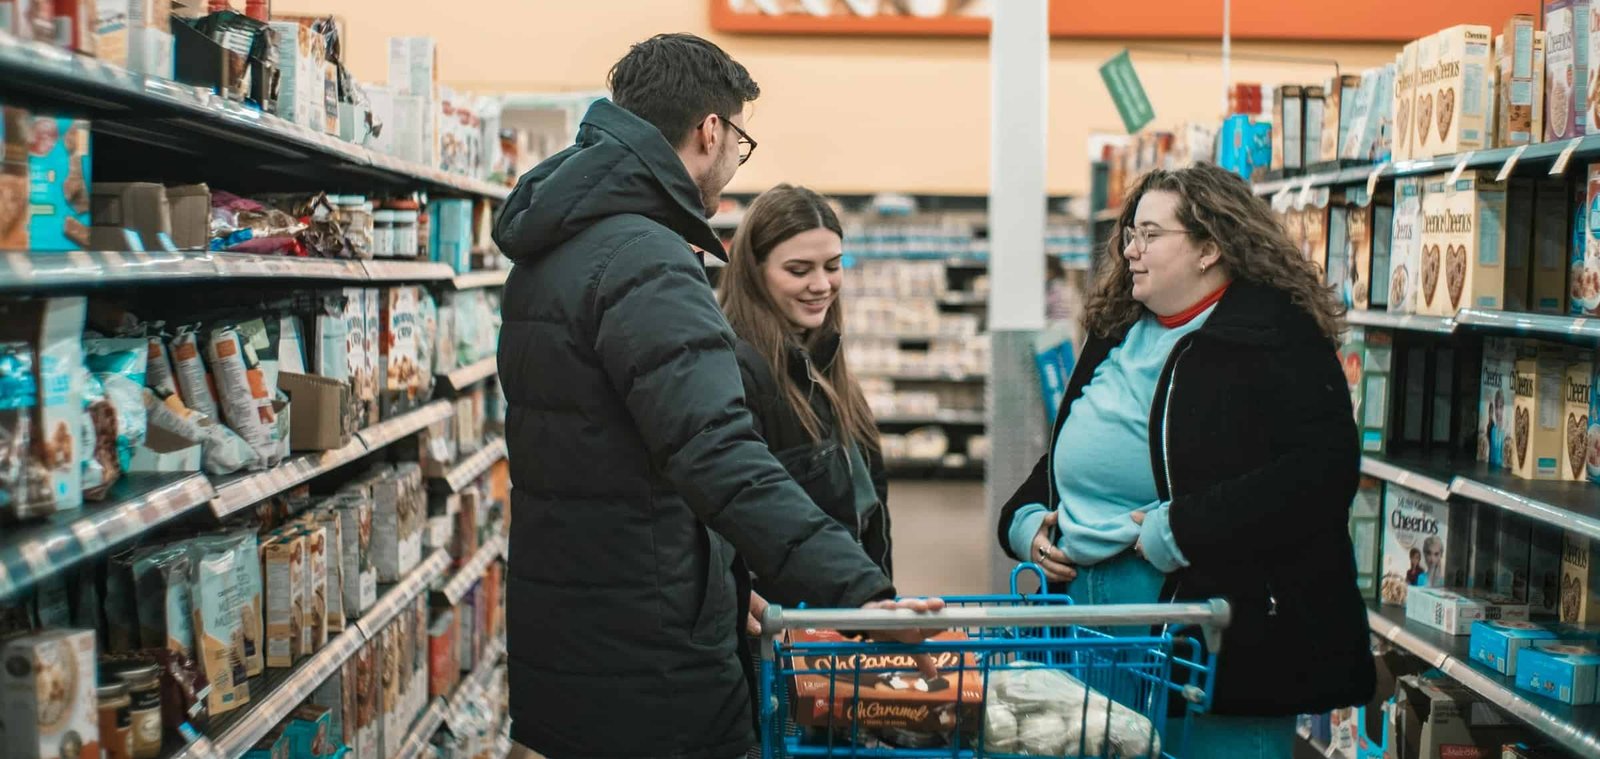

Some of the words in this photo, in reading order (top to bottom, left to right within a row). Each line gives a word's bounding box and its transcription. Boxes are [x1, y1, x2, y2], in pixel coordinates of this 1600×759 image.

[1464, 31, 1488, 40] Cheerios
[1444, 208, 1472, 234] Cheerios
[1483, 367, 1503, 389] Cheerios
[1391, 510, 1439, 534] Cheerios
